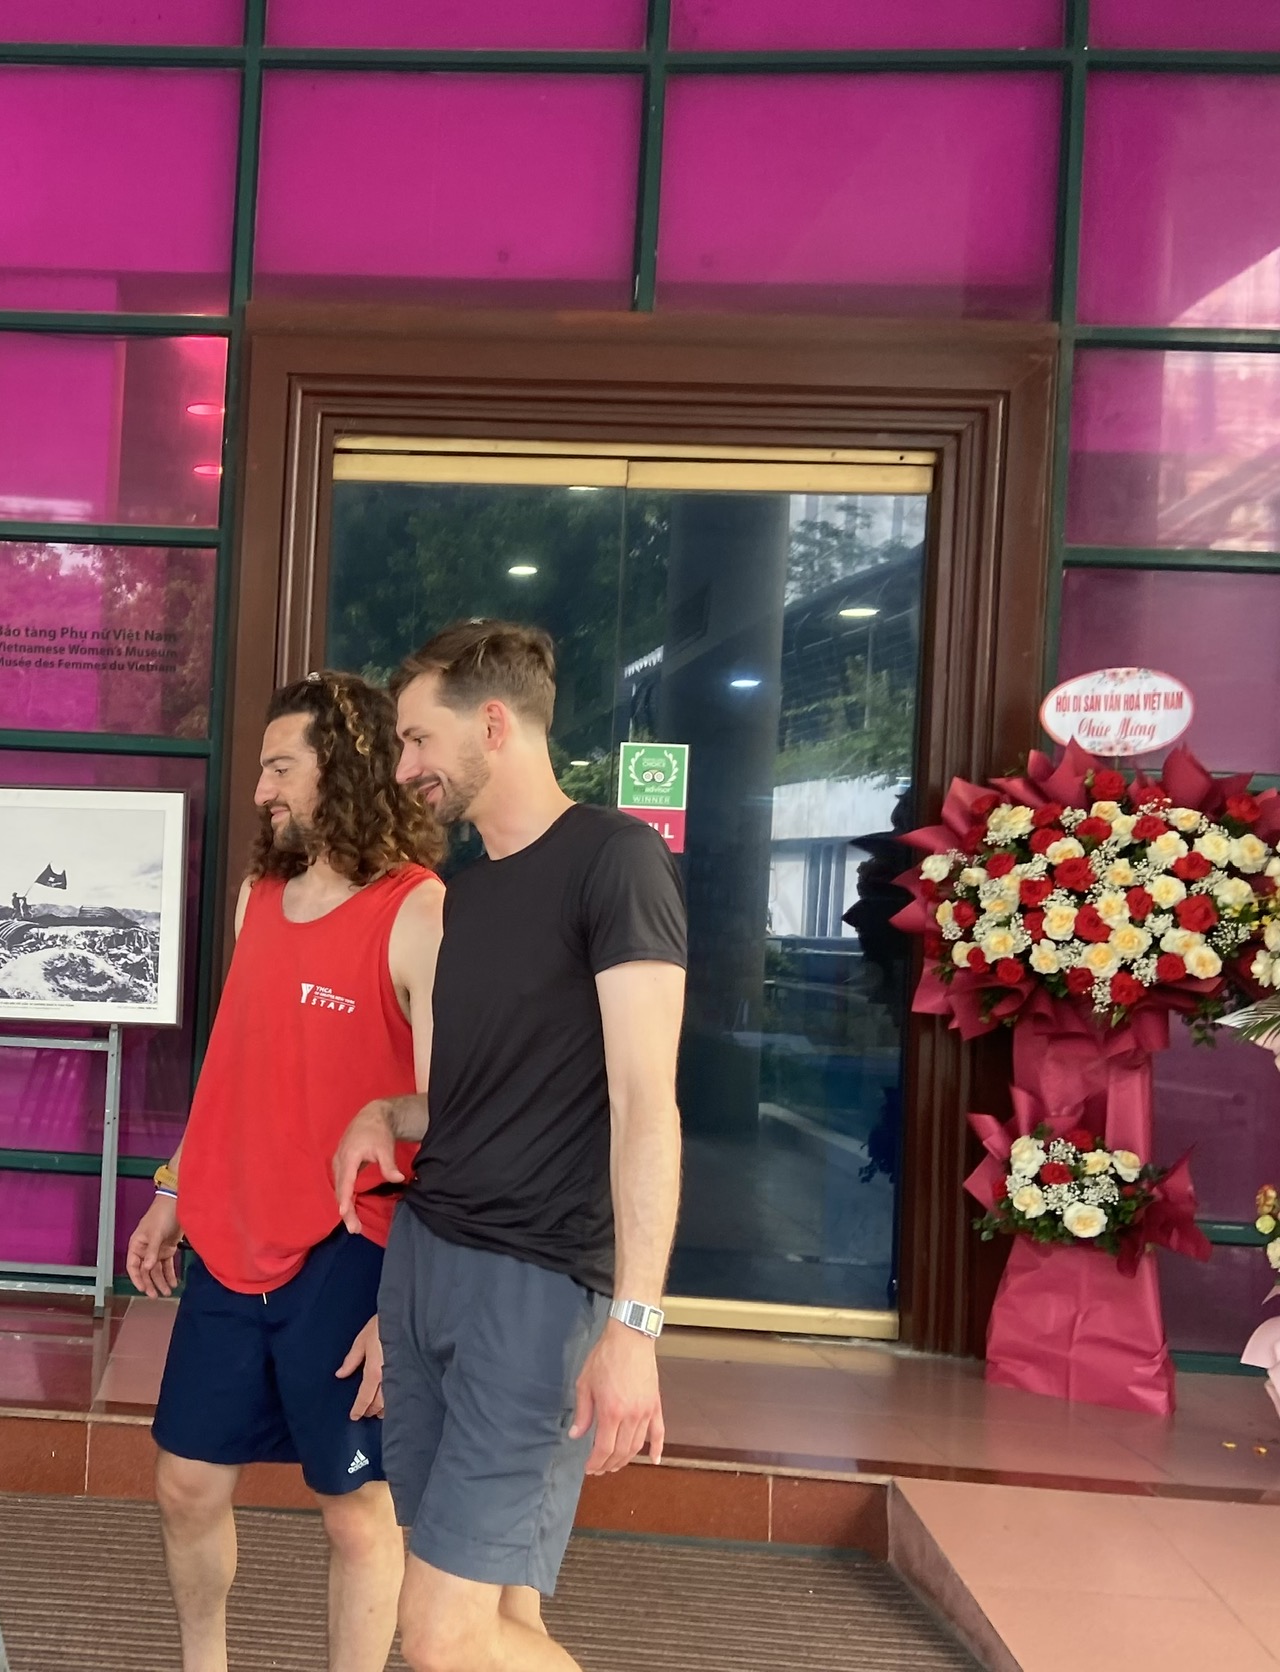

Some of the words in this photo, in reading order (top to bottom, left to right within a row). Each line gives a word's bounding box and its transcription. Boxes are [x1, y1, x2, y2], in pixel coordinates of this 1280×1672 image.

[60, 626, 88, 643] Phụ
[112, 628, 141, 643] Việt
[144, 629, 177, 642] Nam
[125, 645, 177, 658] Museum
[34, 657, 55, 669] des
[57, 658, 108, 671] Femmes
[109, 660, 125, 671] du
[127, 661, 177, 674] Vietnam
[1055, 691, 1071, 717] HỘI
[1072, 693, 1081, 713] DI
[1163, 690, 1184, 711] NAM
[631, 794, 670, 805] WINNER
[311, 998, 355, 1014] STAFF
